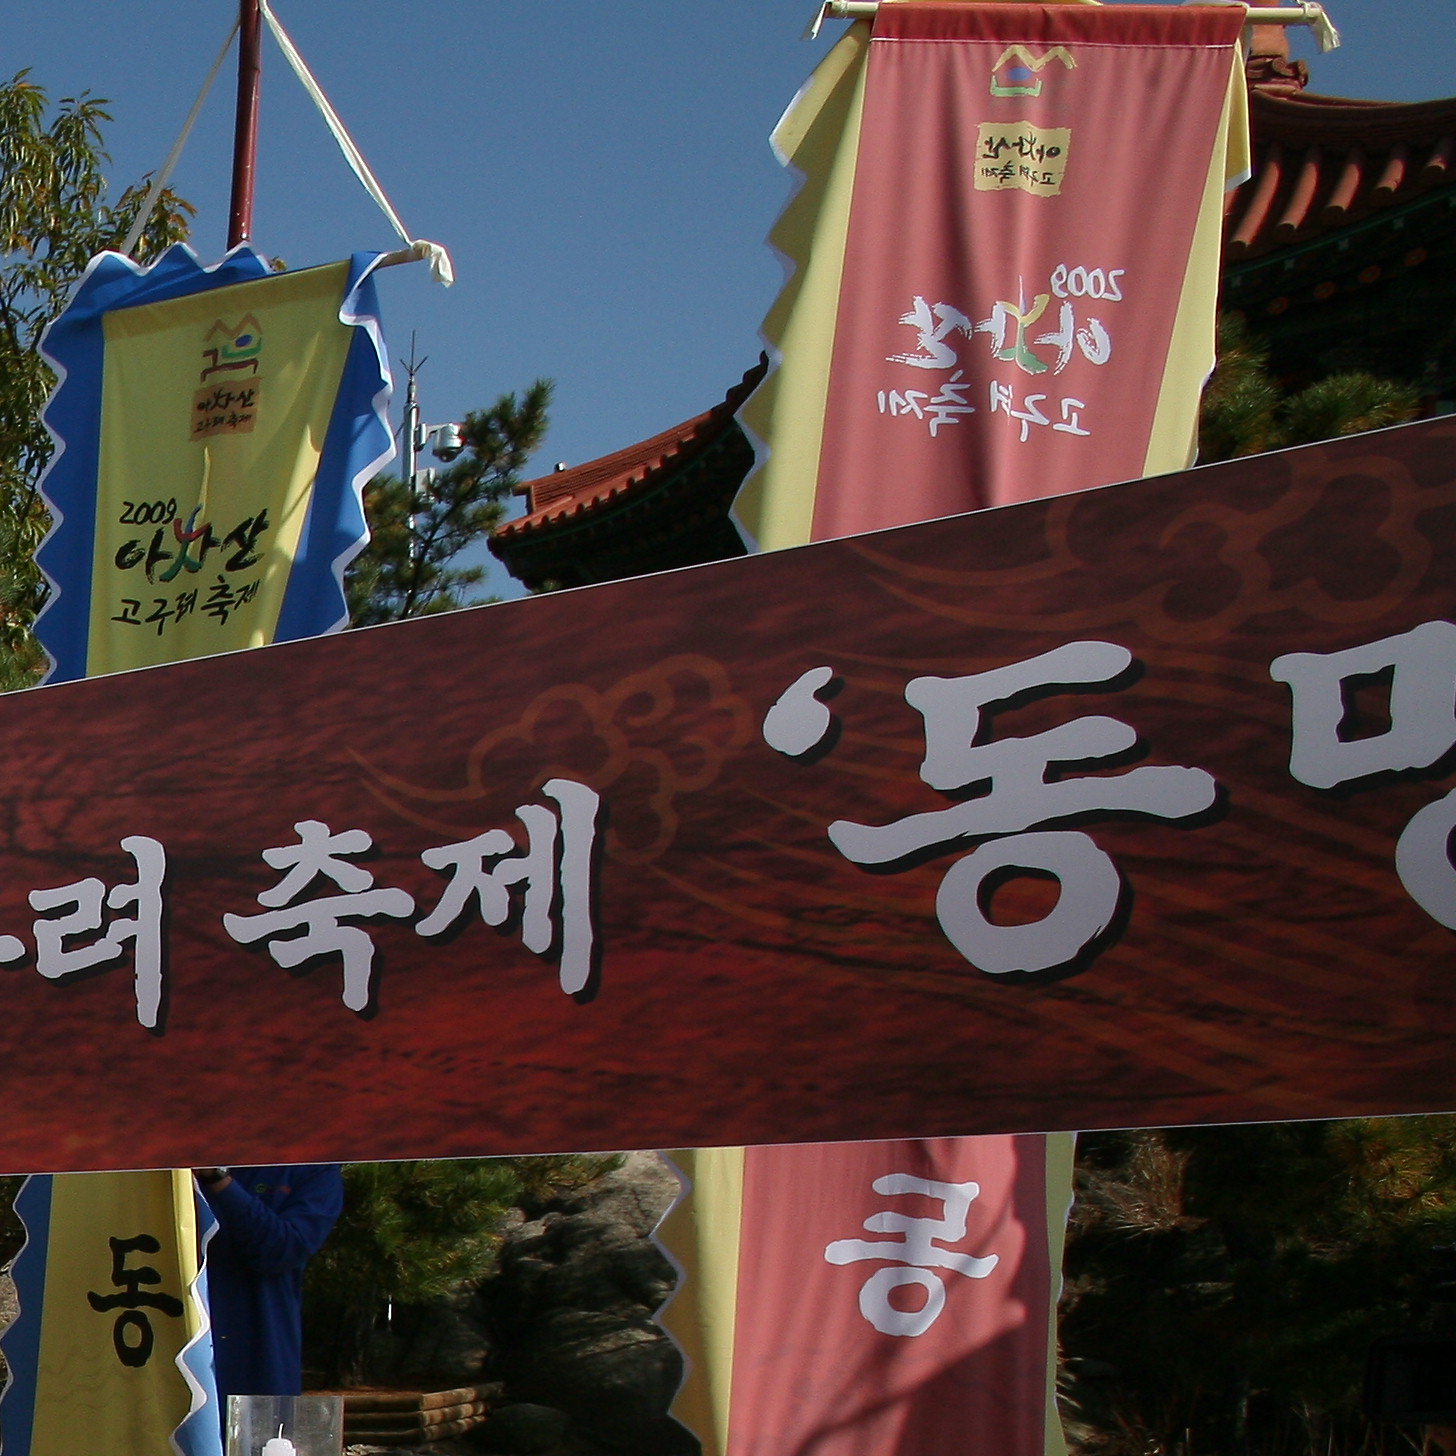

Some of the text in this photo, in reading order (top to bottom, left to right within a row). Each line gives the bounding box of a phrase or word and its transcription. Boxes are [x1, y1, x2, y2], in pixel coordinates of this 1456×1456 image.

[197, 387, 255, 412] 아차산
[114, 504, 269, 584] 아차산
[119, 498, 177, 525] 2009
[110, 574, 260, 636] 고구려 축제
[224, 778, 601, 1012] 축제
[87, 1233, 185, 1367] 동
